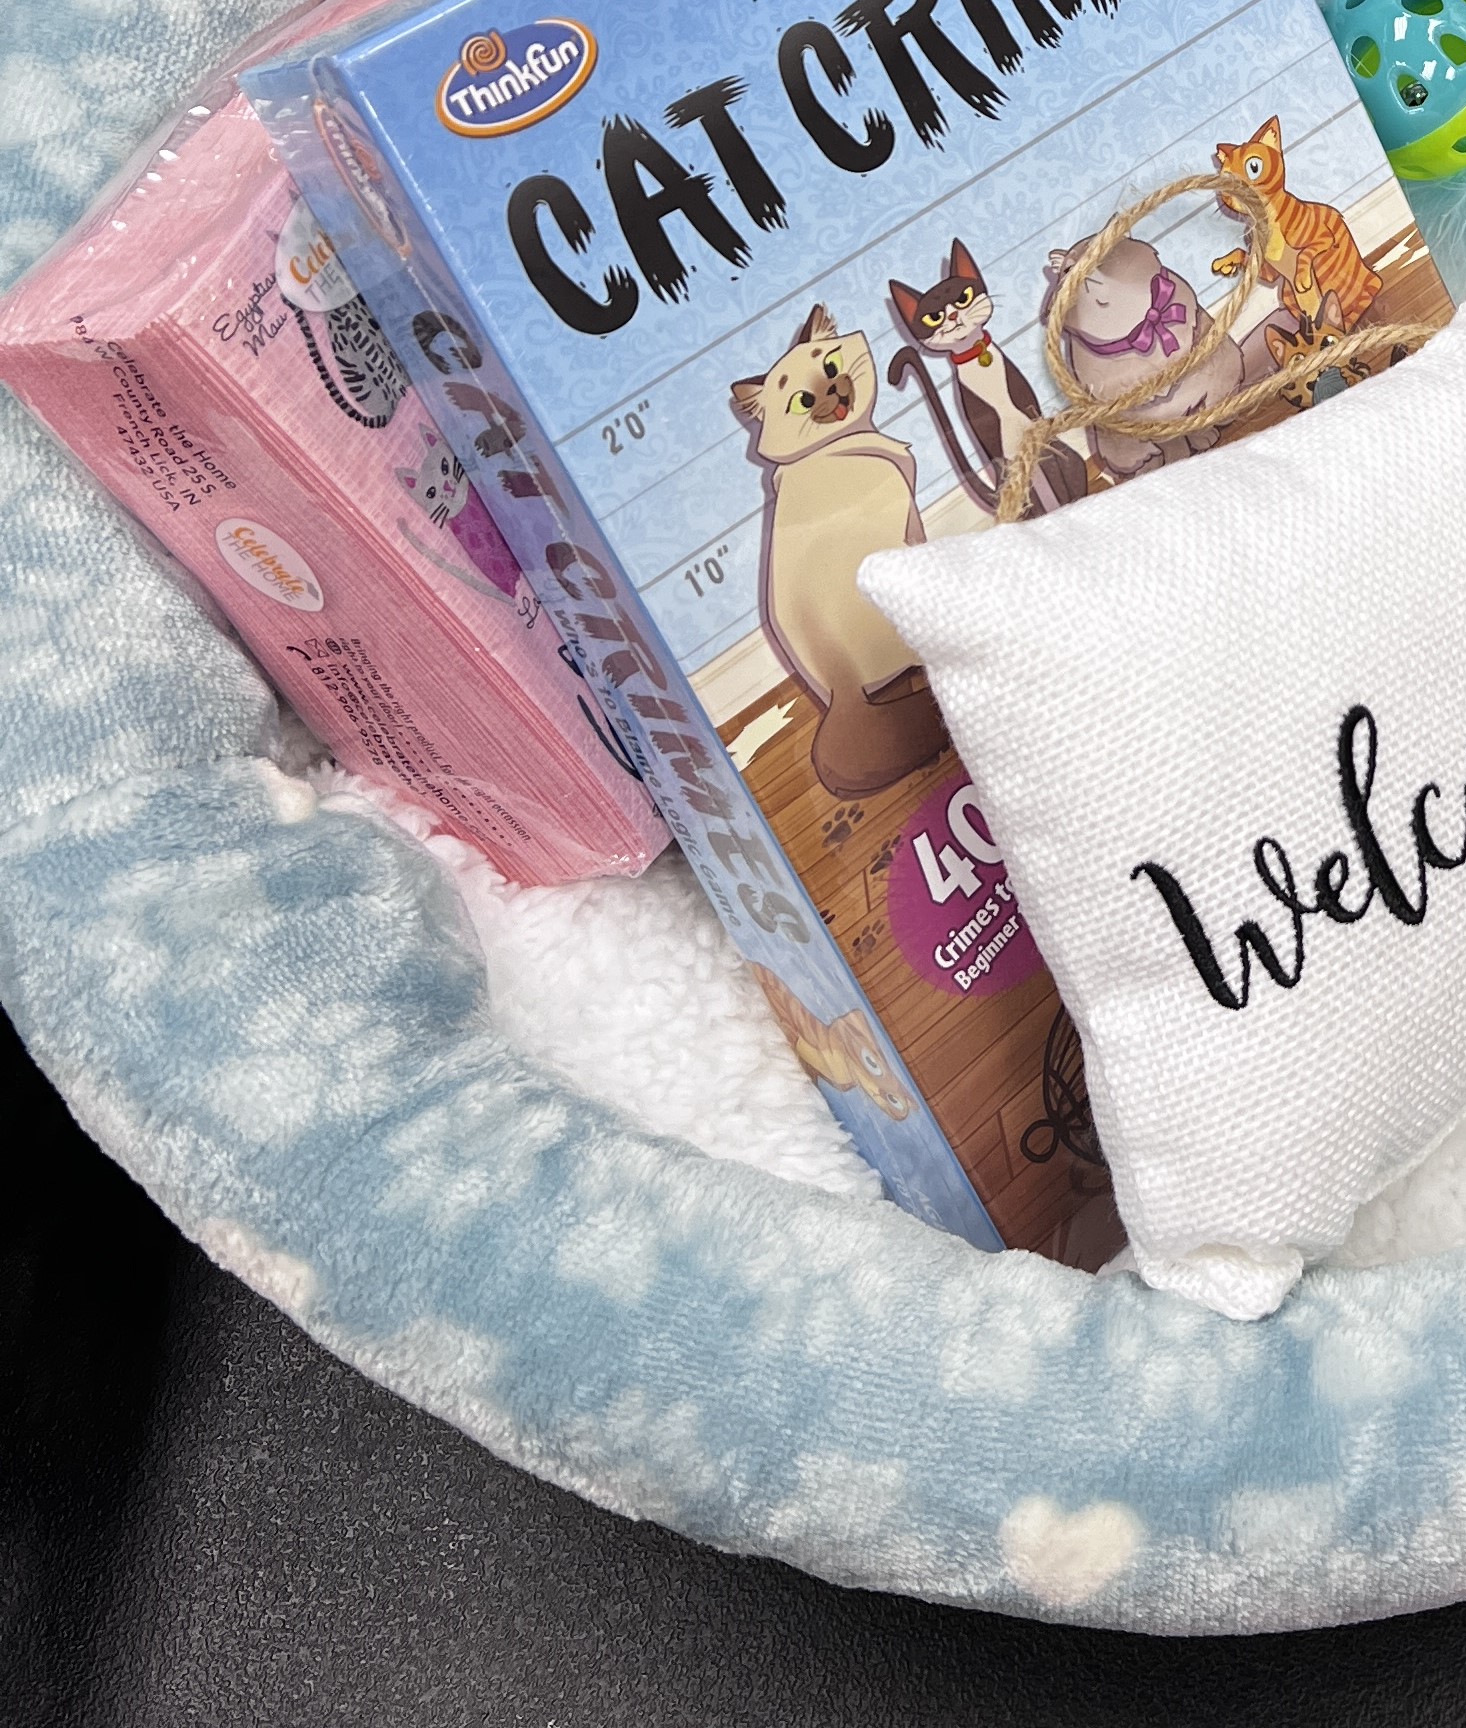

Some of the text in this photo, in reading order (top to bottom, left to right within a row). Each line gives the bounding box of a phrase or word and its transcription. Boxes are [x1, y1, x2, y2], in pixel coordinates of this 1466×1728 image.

[449, 38, 579, 118] Thinkfun
[507, 74, 790, 337] CAT
[243, 313, 288, 357] Mau
[107, 341, 237, 490] Celebrate the Home
[113, 366, 153, 426] County
[151, 427, 189, 465] Road
[182, 465, 206, 484] 25
[113, 393, 150, 448] French
[180, 488, 202, 506] IN
[116, 426, 181, 512] 47432 USA
[934, 897, 1000, 969] Crimes
[953, 915, 1020, 991] Beginner
